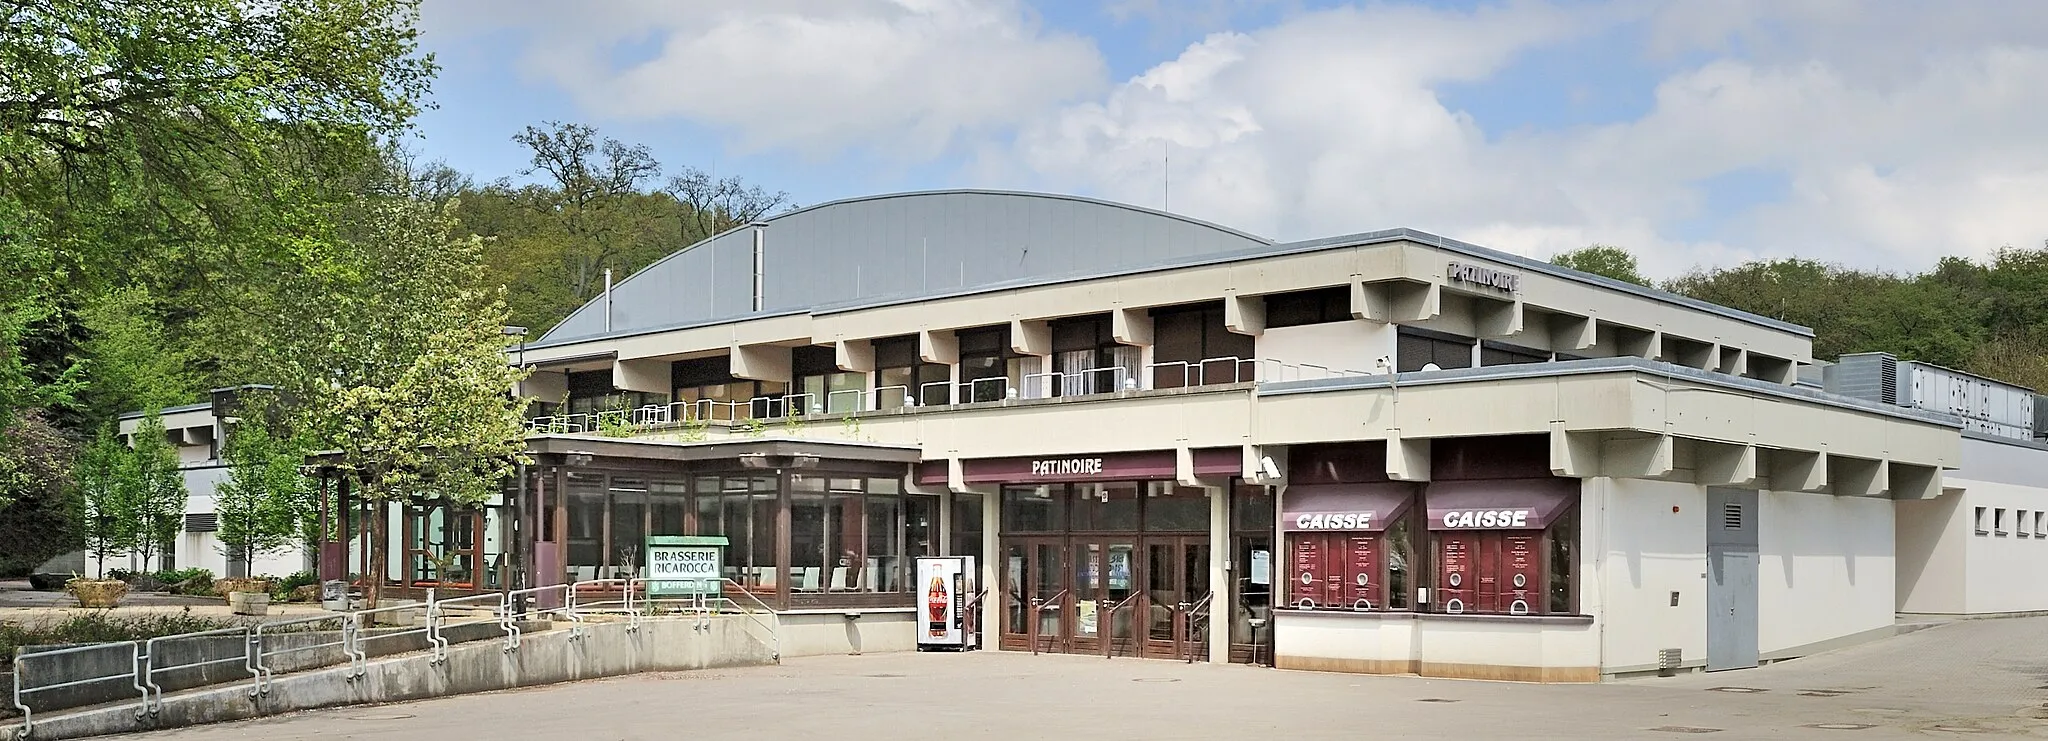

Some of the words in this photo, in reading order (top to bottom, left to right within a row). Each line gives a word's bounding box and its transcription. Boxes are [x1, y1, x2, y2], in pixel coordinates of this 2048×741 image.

[1448, 261, 1519, 292] PATINOIRE
[1032, 458, 1102, 476] PATINOIRE
[1297, 513, 1371, 529] CAISSE
[1443, 510, 1528, 528] CAISSE
[654, 551, 716, 561] BRASSERIE
[654, 563, 715, 573] RICAROCCA
[661, 581, 708, 589] BOFFERDN
